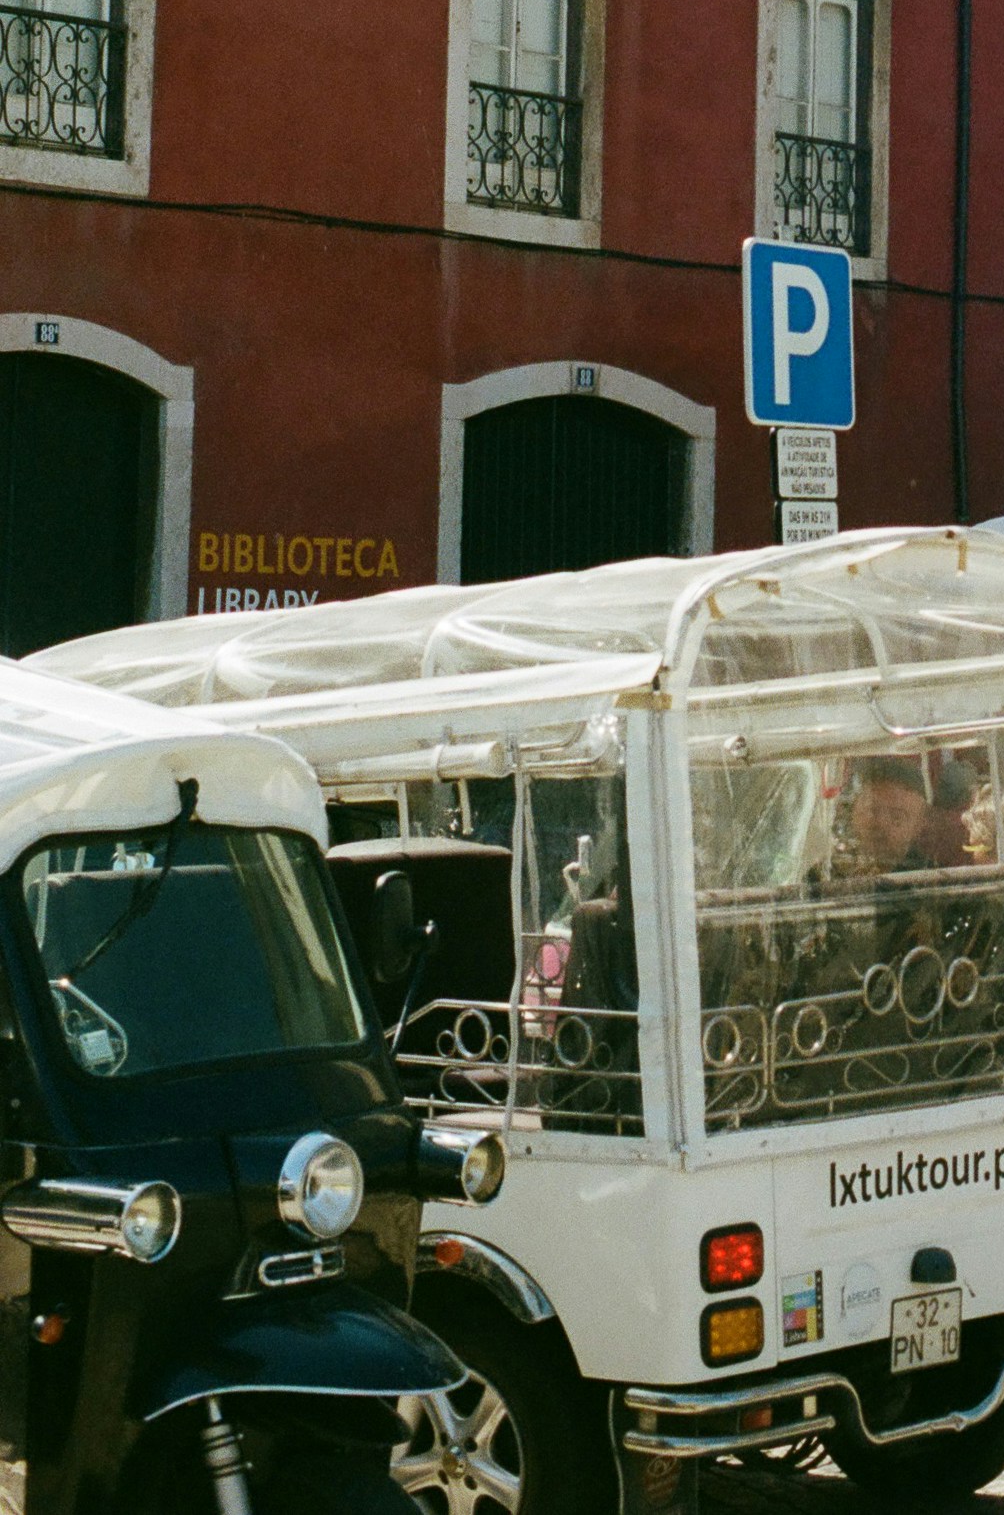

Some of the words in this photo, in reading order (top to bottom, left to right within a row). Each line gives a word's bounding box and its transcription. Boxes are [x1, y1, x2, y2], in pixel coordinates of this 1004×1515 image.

[772, 262, 830, 405] P
[789, 511, 801, 523] DAS
[199, 533, 400, 578] BIBLIOTECA
[916, 1297, 939, 1329] 32
[893, 1334, 924, 1367] PN
[940, 1326, 958, 1357] 10
